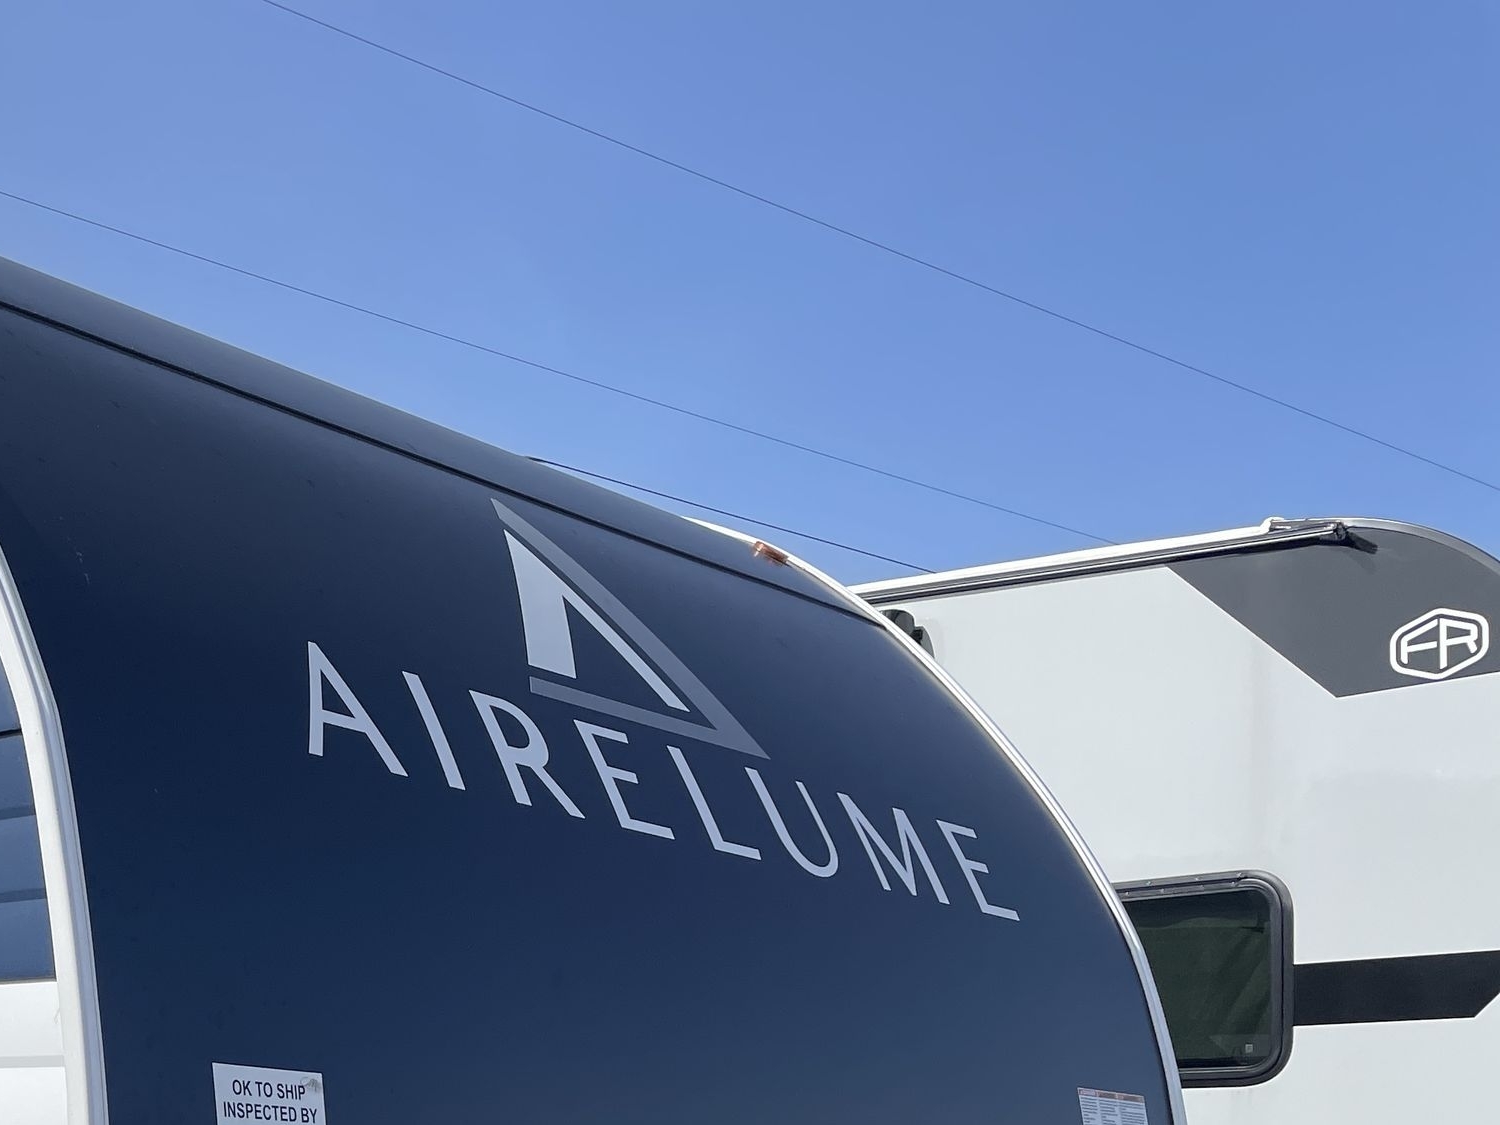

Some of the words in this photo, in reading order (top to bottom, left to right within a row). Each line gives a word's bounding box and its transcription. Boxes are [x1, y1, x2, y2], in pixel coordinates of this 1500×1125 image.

[308, 641, 1020, 922] AIRELUME
[232, 1079, 252, 1097] OK
[255, 1081, 273, 1098] TO
[276, 1083, 306, 1100] SHIP
[223, 1101, 297, 1122] INSPECTED
[301, 1107, 318, 1124] BY
